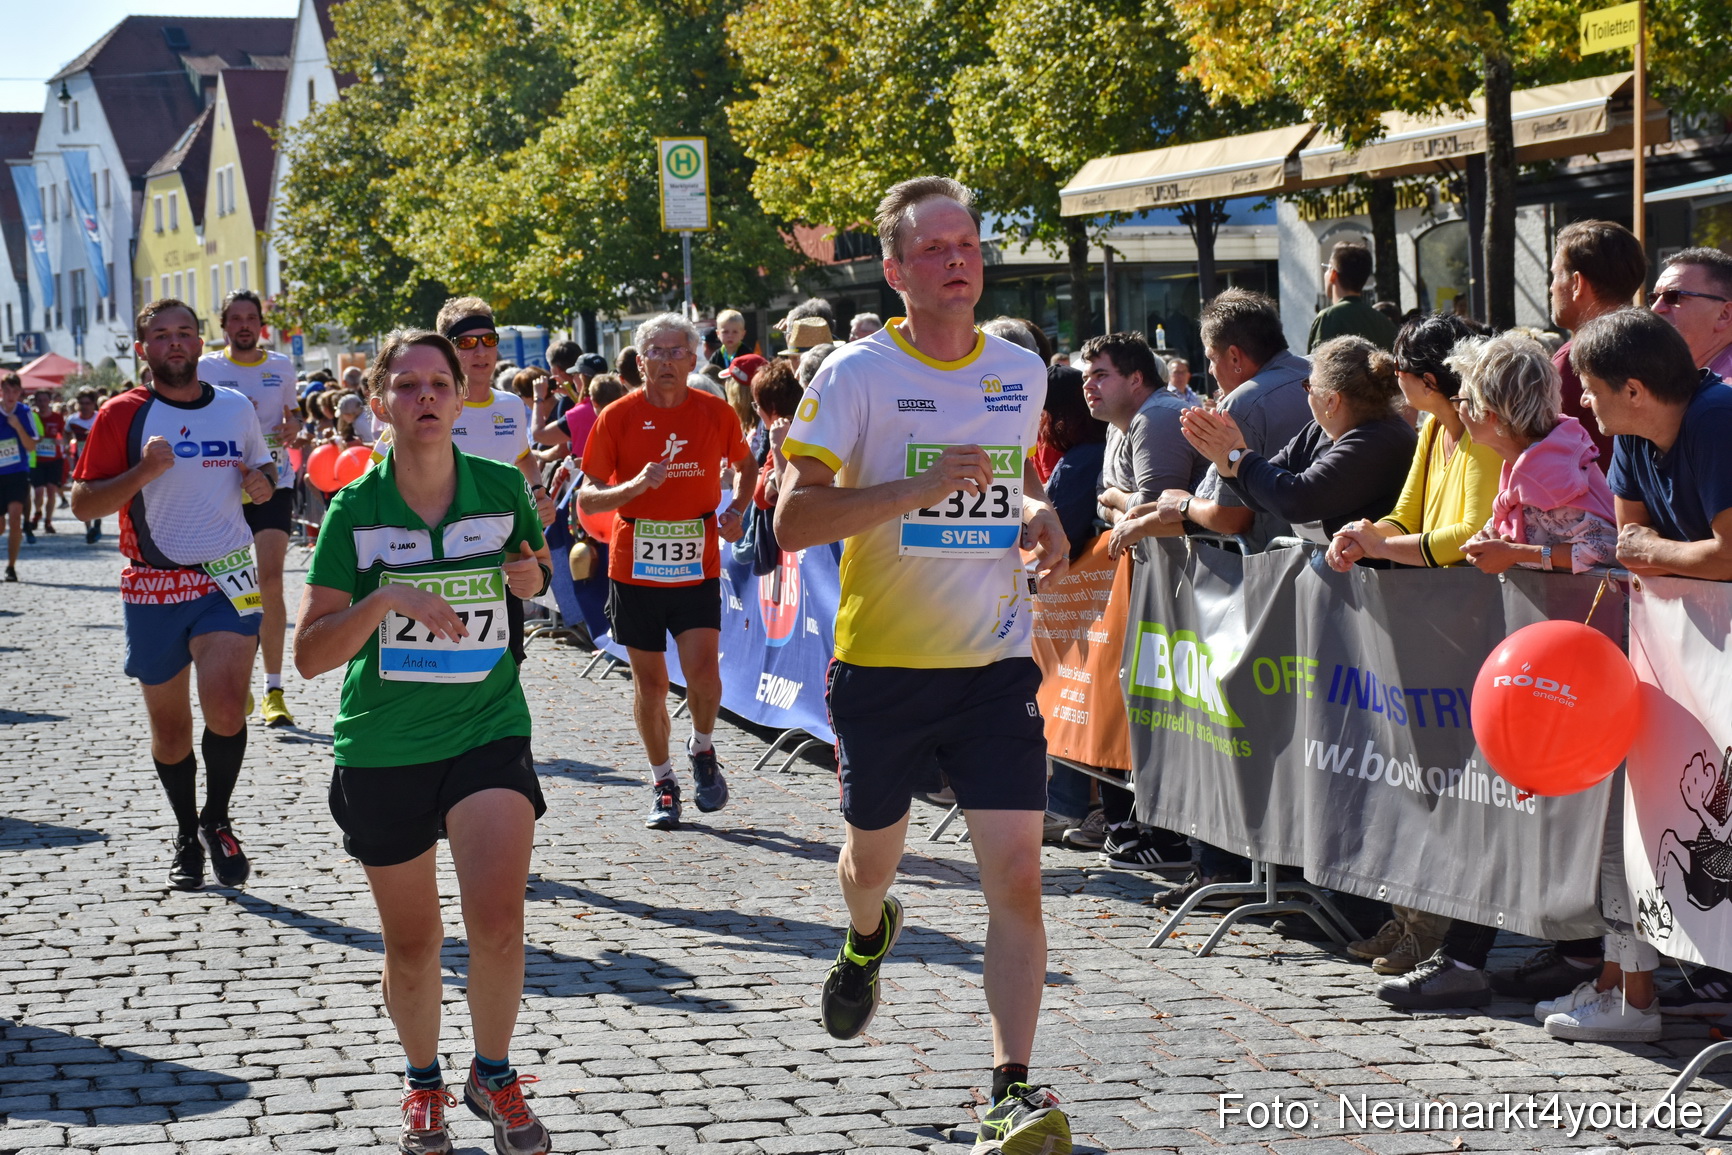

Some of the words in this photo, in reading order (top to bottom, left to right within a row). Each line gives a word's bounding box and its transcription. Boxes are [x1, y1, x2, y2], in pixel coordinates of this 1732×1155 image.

[1592, 18, 1636, 40] Toiletten
[675, 152, 692, 172] H
[982, 379, 1002, 393] 20
[898, 400, 936, 408] BOCK
[984, 394, 1028, 403] Neumarkter
[987, 404, 1022, 413] Stadtlauf
[202, 459, 240, 468] energ
[666, 462, 699, 470] unners
[915, 448, 1015, 474] BK
[640, 522, 699, 537] BOCK
[941, 530, 990, 545] SVEN
[397, 542, 416, 550] JAKO
[642, 541, 697, 561] 2133
[212, 550, 253, 574] BOC
[645, 566, 692, 576] MICHAEL
[1081, 569, 1114, 582] Partner
[389, 574, 497, 601] OCK
[1044, 608, 1077, 624] Projekte
[402, 654, 438, 669] Andrea
[1533, 691, 1575, 708] energie
